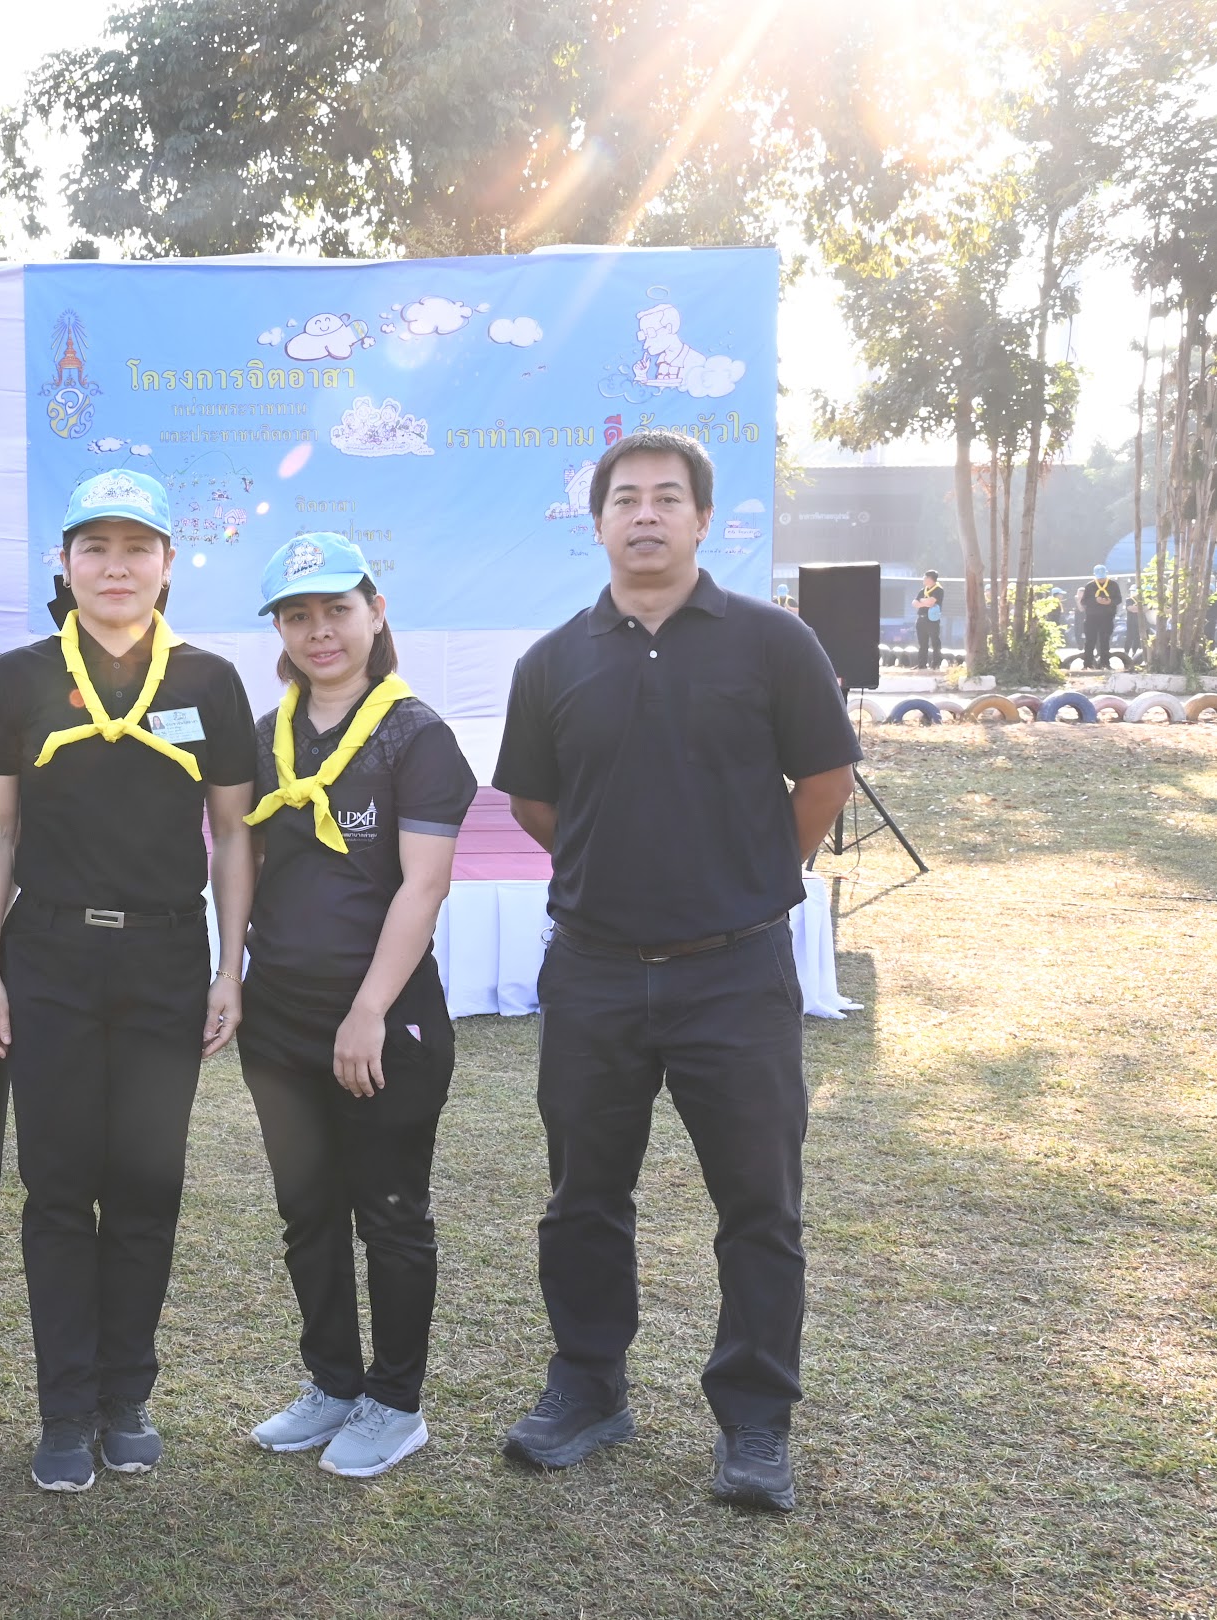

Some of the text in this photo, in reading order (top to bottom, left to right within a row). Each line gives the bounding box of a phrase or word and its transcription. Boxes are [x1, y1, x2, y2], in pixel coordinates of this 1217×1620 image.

[126, 359, 356, 391] โครงการจิตอาสา
[173, 397, 307, 417] หน่วยพระราชทาน
[160, 424, 319, 443] และประชาชนจิตอาสา
[446, 419, 594, 448] เราทำความ
[604, 414, 623, 446] ดี
